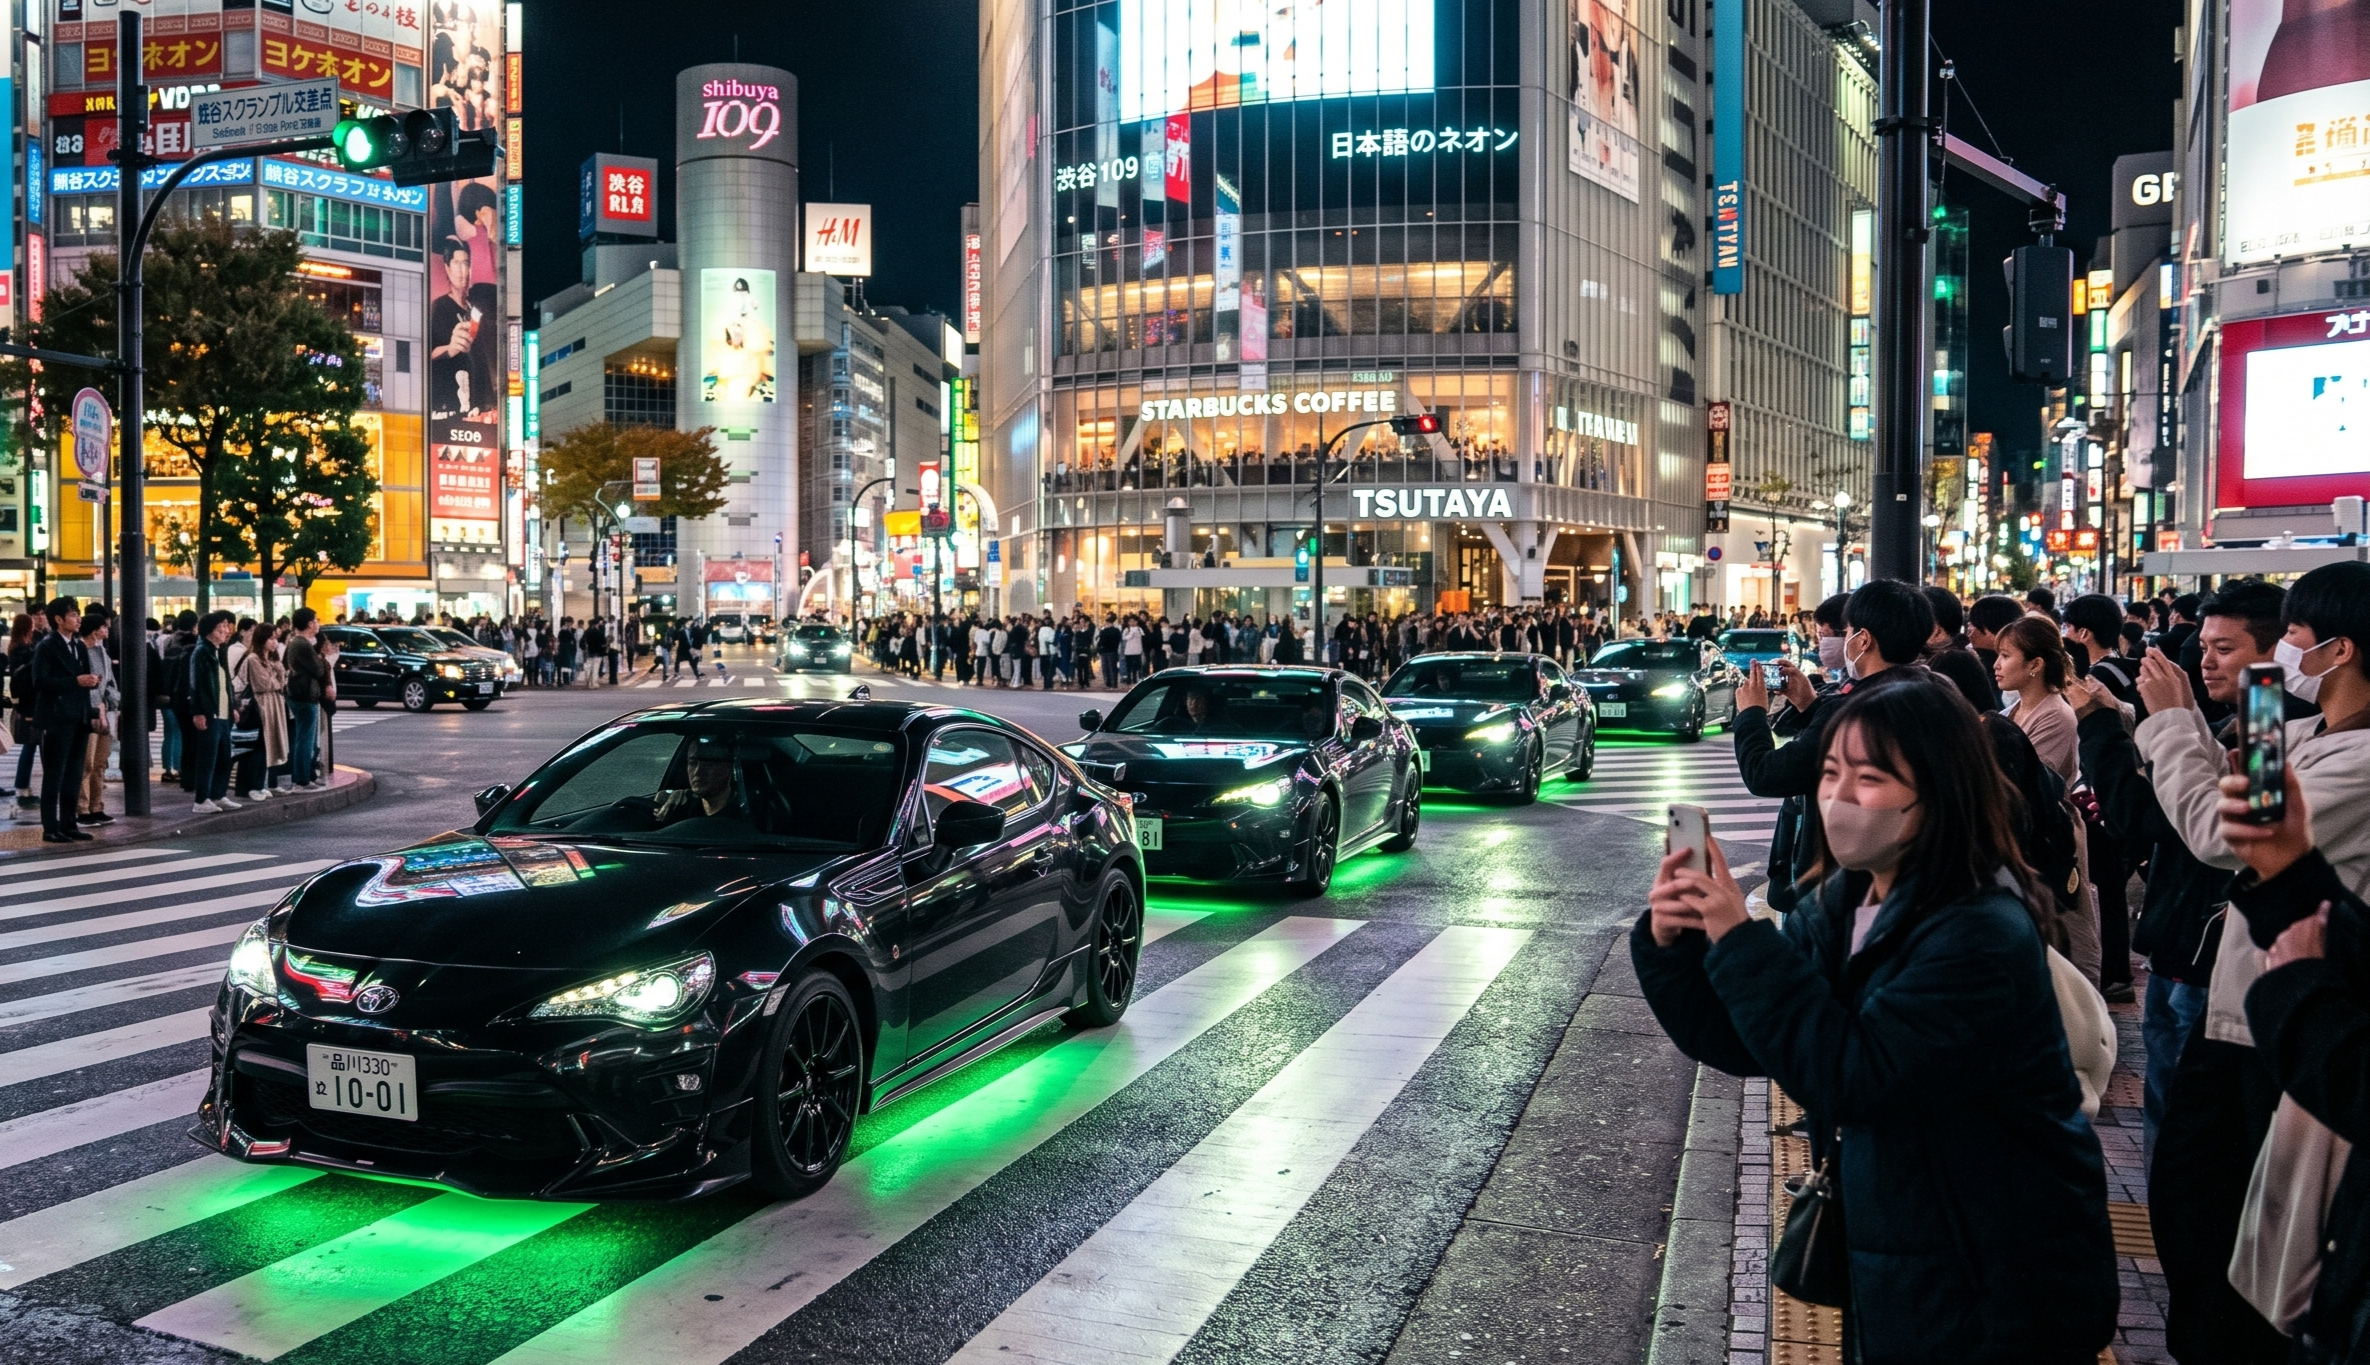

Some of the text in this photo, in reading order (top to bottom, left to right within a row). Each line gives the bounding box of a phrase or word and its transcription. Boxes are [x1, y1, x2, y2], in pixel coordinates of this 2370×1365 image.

[703, 79, 779, 102] shibuya
[696, 100, 780, 150] 109
[1332, 126, 1518, 159] 日本語のネオン
[816, 217, 861, 247] H&M
[1141, 390, 1396, 422] STARBUCKS COFFEE
[1353, 488, 1514, 518] TSUTAYA
[335, 1075, 406, 1114] 10-01
